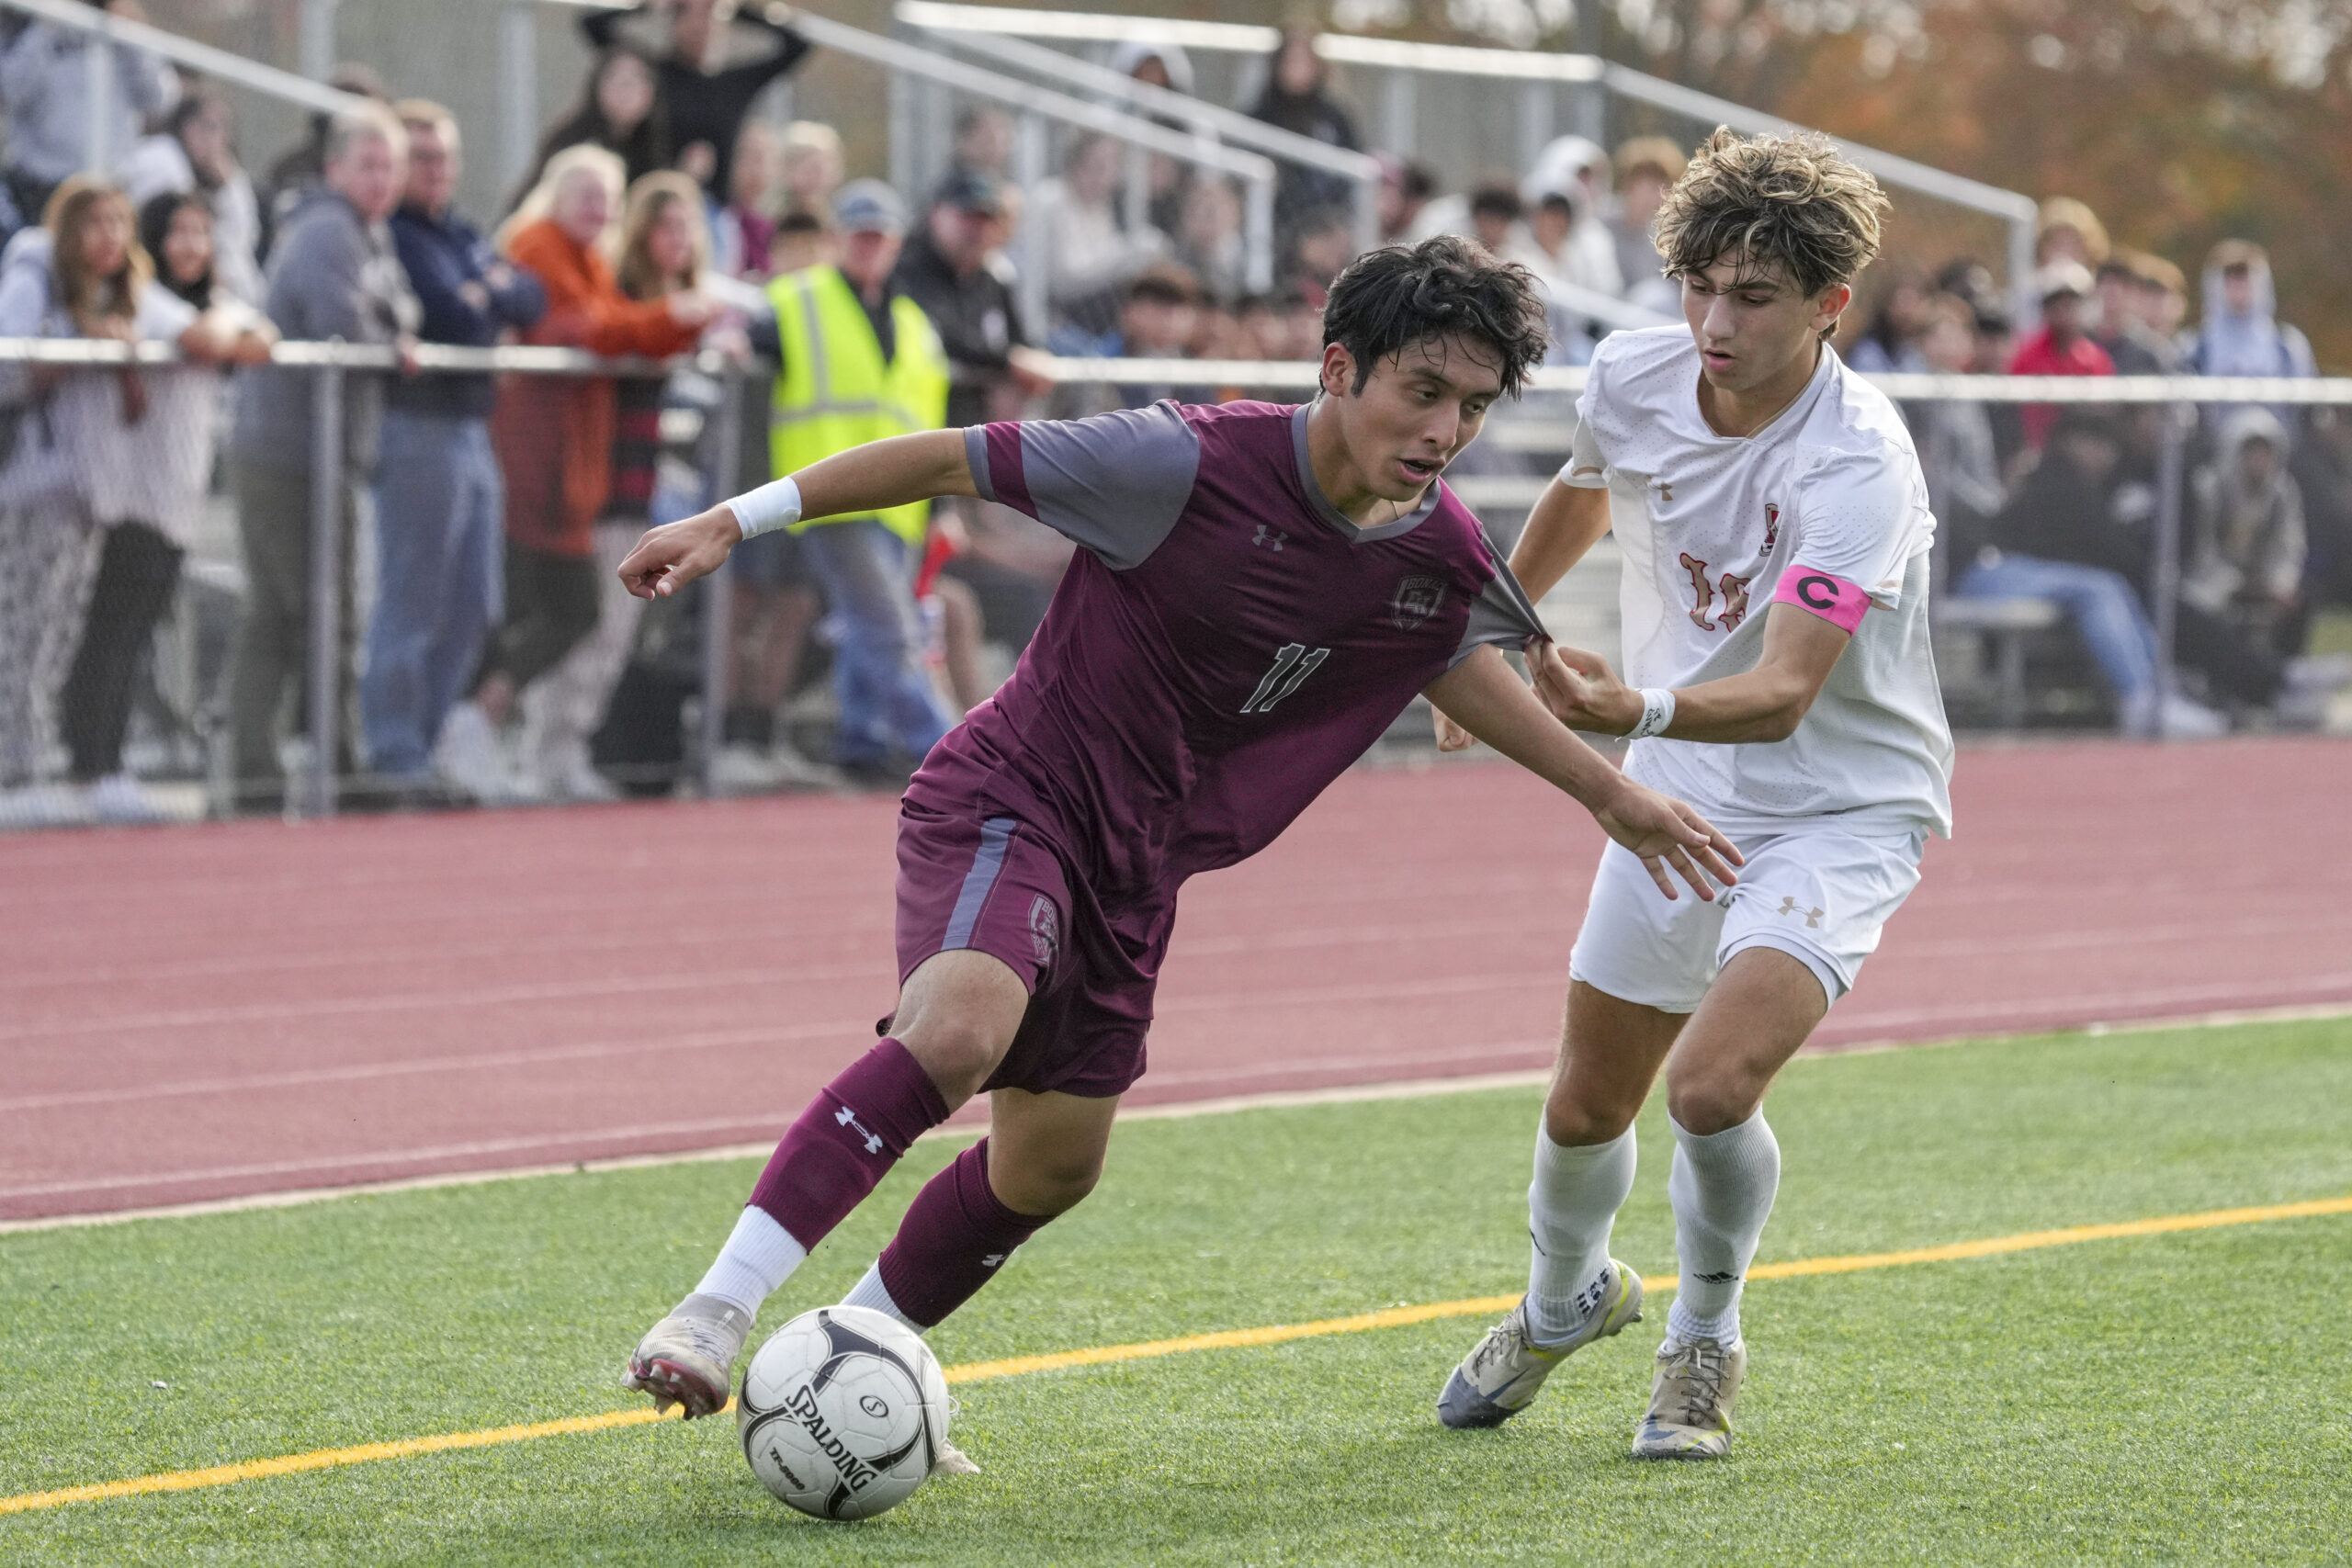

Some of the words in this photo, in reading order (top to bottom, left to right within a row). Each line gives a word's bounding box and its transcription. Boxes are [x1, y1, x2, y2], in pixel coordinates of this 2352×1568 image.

[1797, 576, 1839, 610] C
[1240, 643, 1331, 714] 11
[785, 1384, 878, 1494] SPALDING
[770, 1447, 805, 1490] TF-5000
